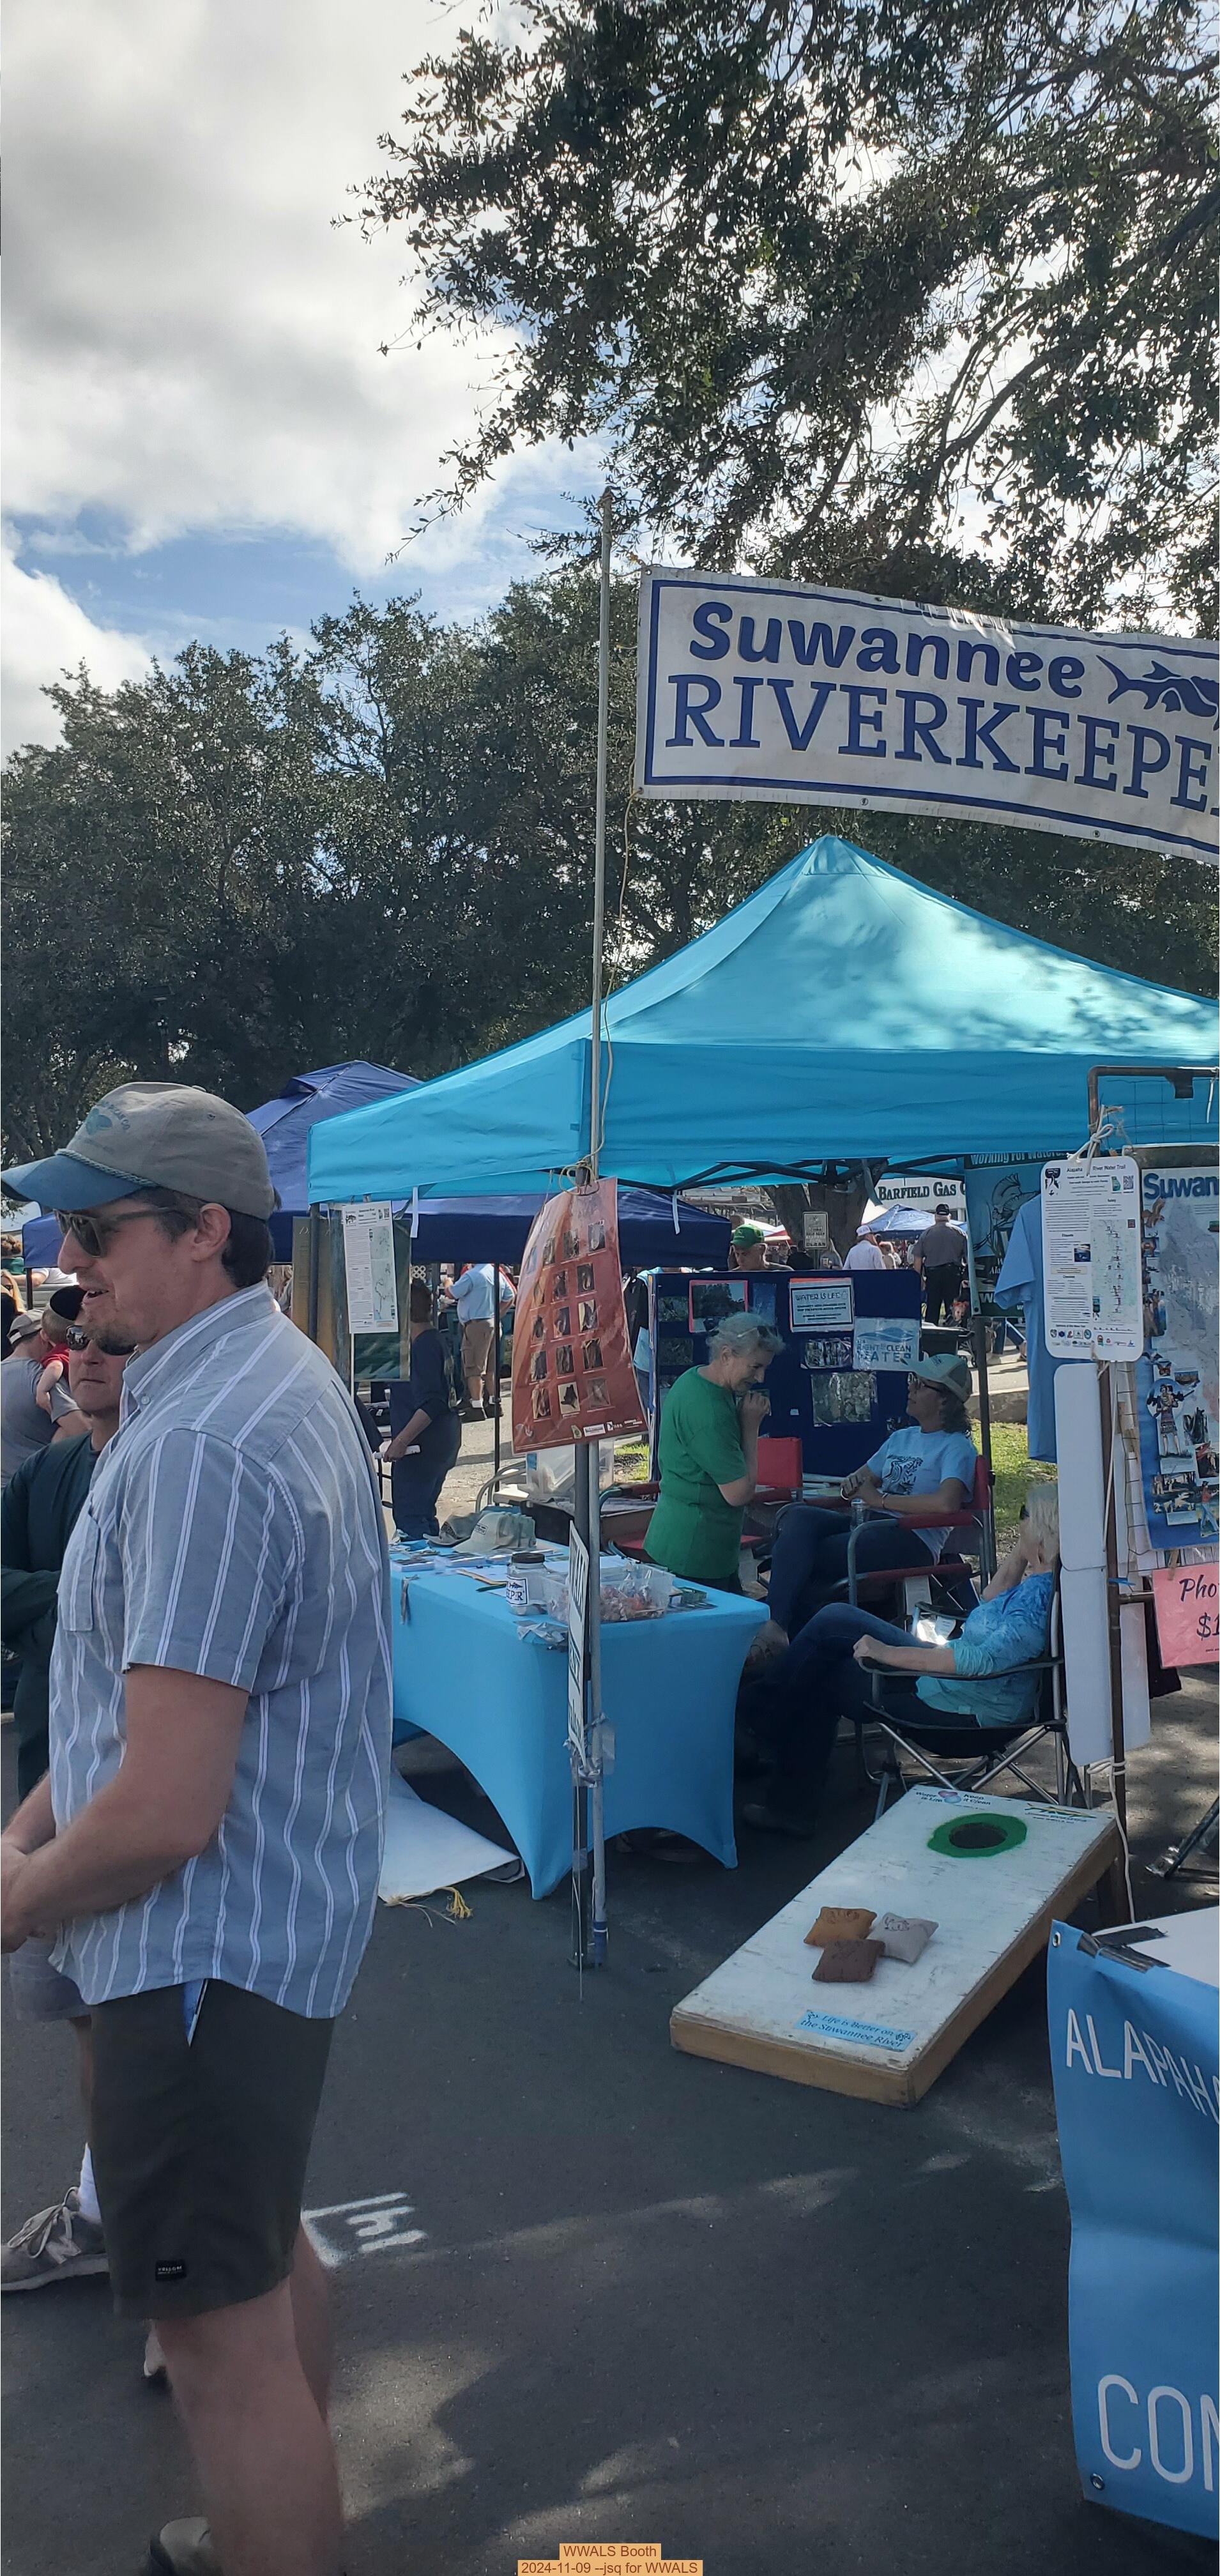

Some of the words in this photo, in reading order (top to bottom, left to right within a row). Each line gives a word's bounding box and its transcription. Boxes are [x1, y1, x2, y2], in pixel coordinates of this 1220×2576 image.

[689, 602, 1085, 699] Suwannee
[665, 674, 1219, 817] RIVERKEEPE
[1143, 1173, 1219, 1199] Suwan
[1179, 1574, 1219, 1602] Pho
[800, 2020, 818, 2028] the
[818, 2023, 874, 2041] Suwannee
[874, 2035, 903, 2048] River
[821, 2014, 841, 2025] Life
[850, 2021, 880, 2034] Better
[881, 2029, 894, 2037] on
